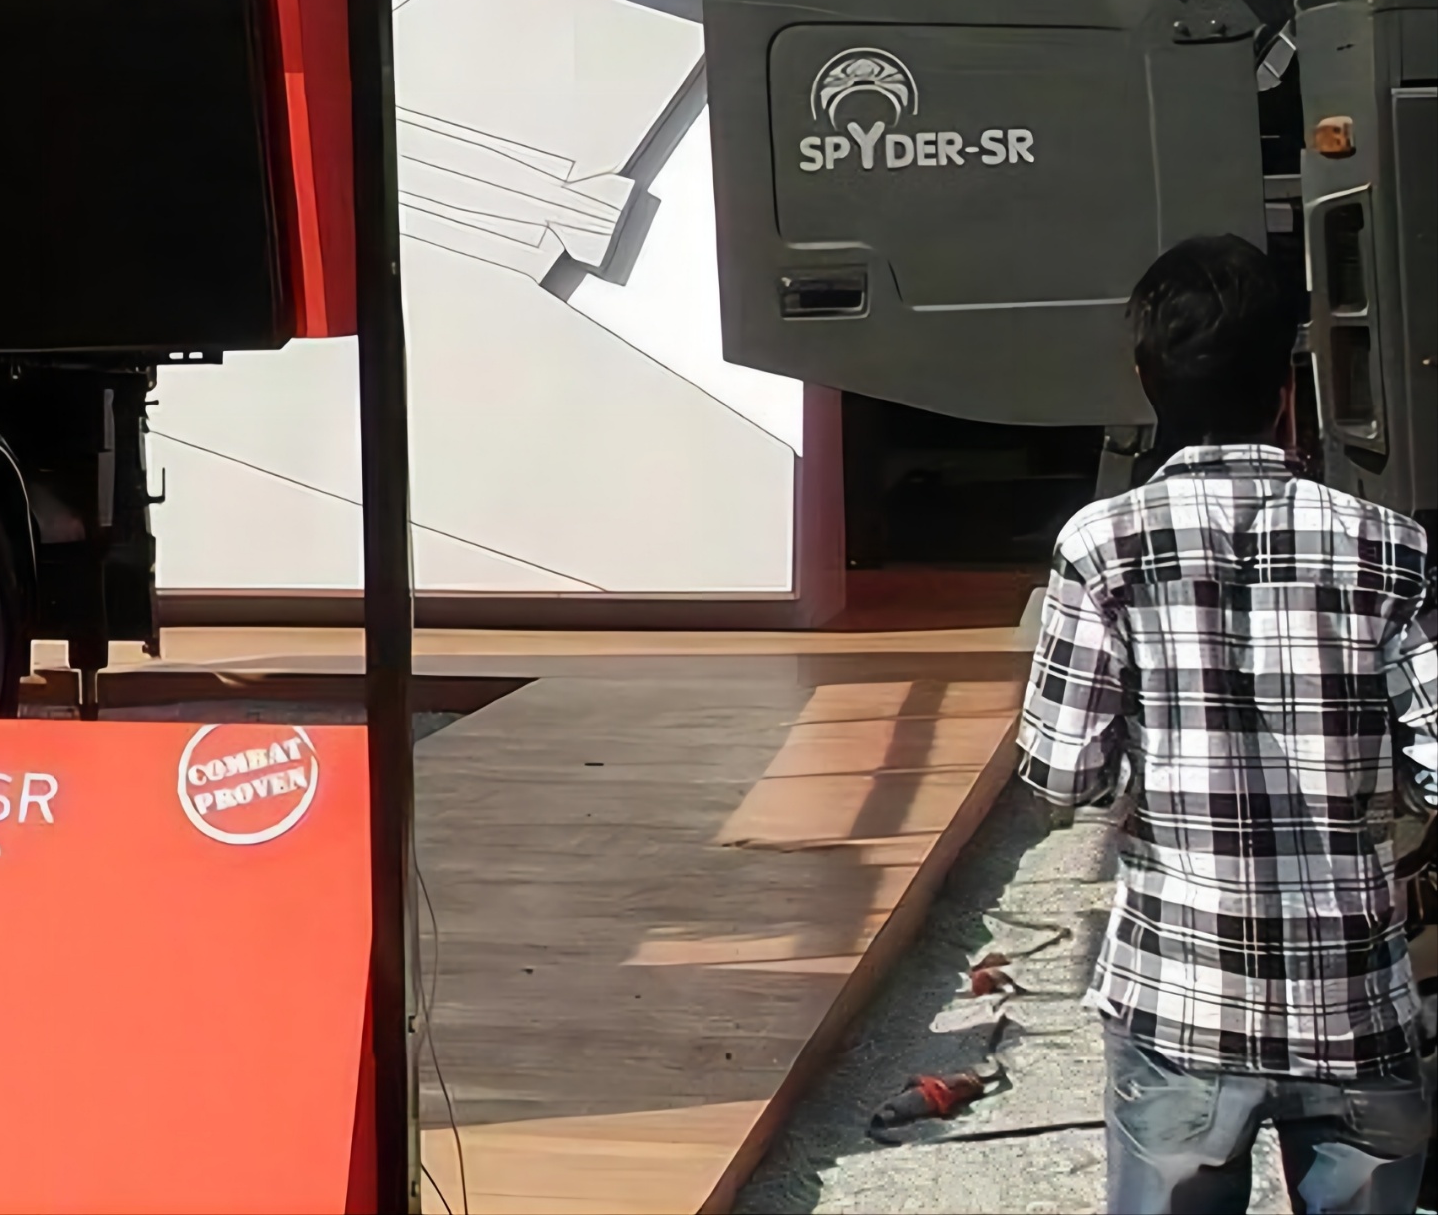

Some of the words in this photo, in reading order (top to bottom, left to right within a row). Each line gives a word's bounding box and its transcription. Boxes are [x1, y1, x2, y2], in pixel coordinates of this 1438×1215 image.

[799, 121, 1035, 172] SPYDER-SR
[188, 736, 303, 786] COMBAT
[193, 766, 308, 815] PROVEN
